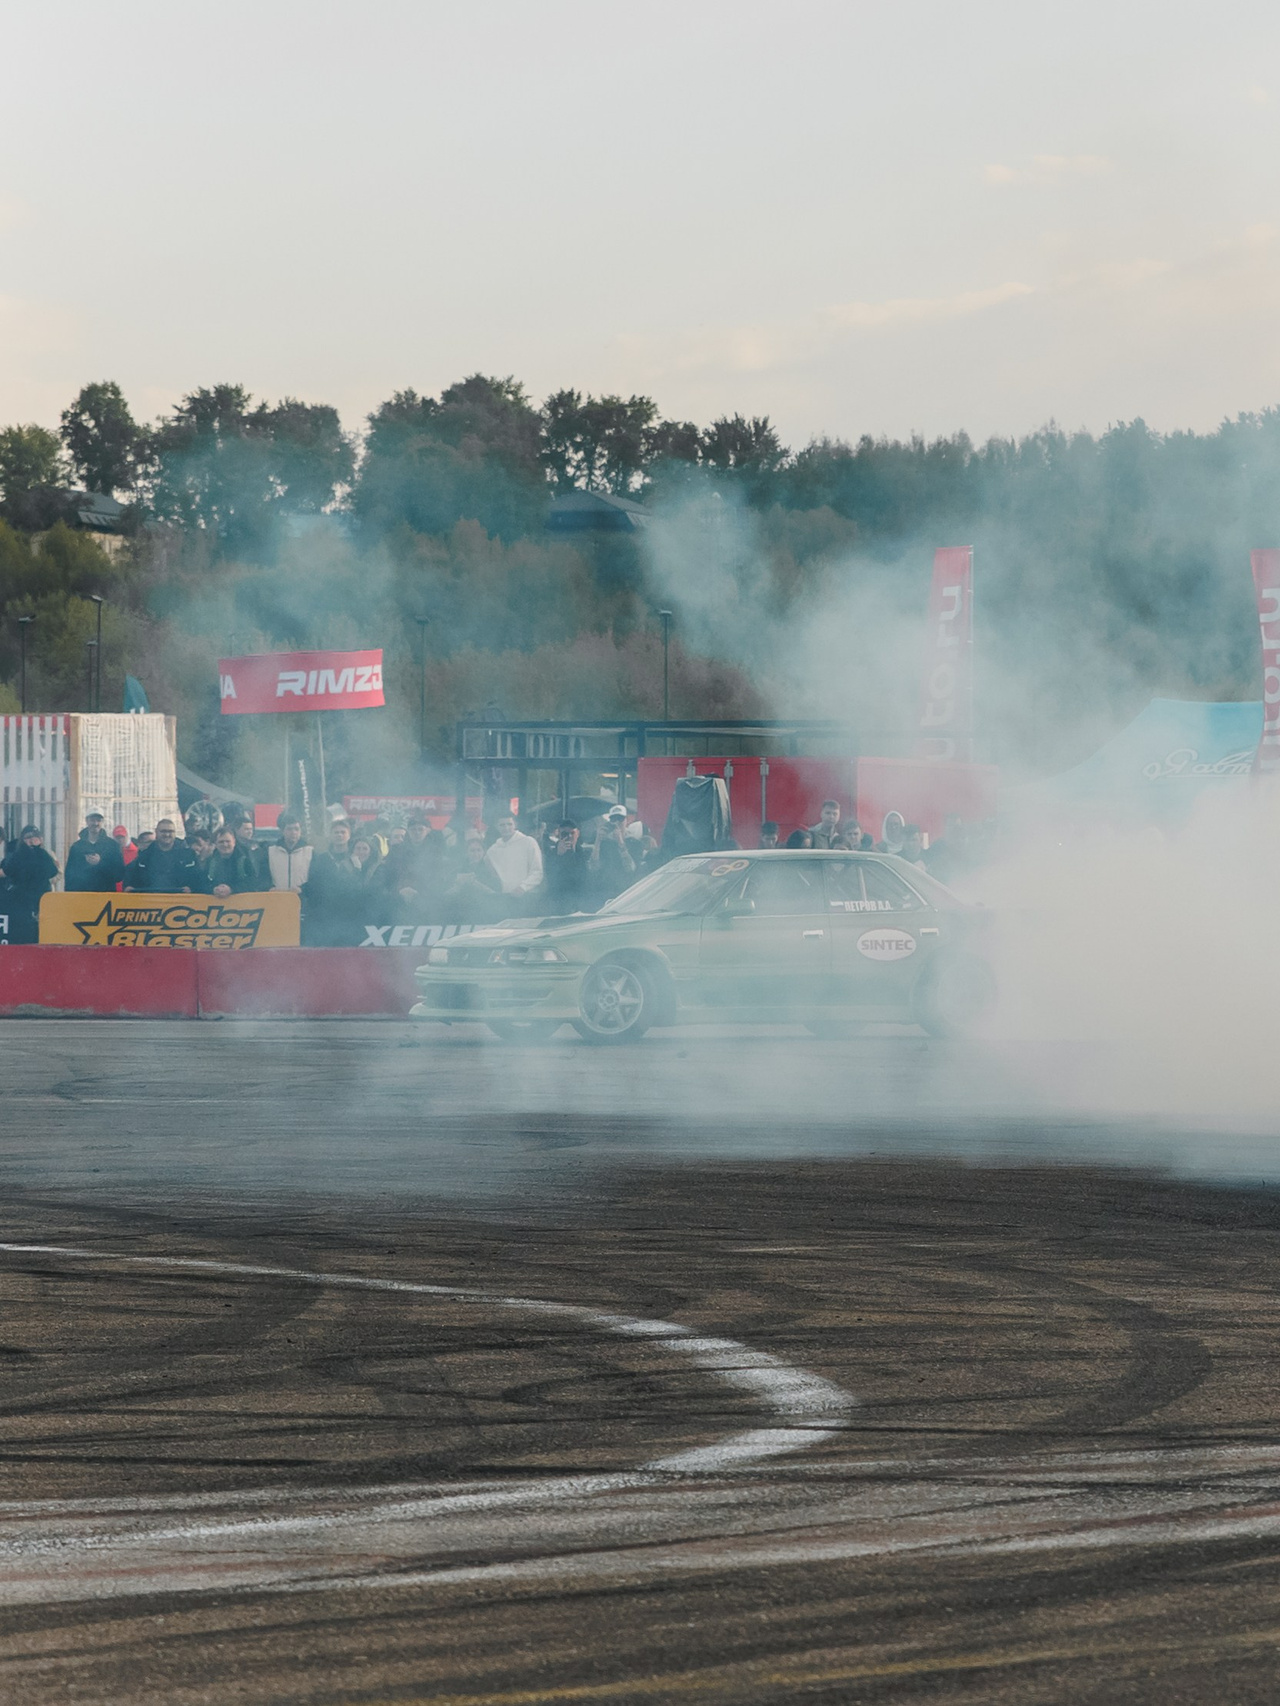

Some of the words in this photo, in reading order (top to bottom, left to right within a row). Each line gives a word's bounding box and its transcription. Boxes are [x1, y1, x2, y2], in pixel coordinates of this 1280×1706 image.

[919, 585, 962, 763] uto.ru
[164, 909, 260, 929] Color
[861, 939, 913, 951] SINTEC
